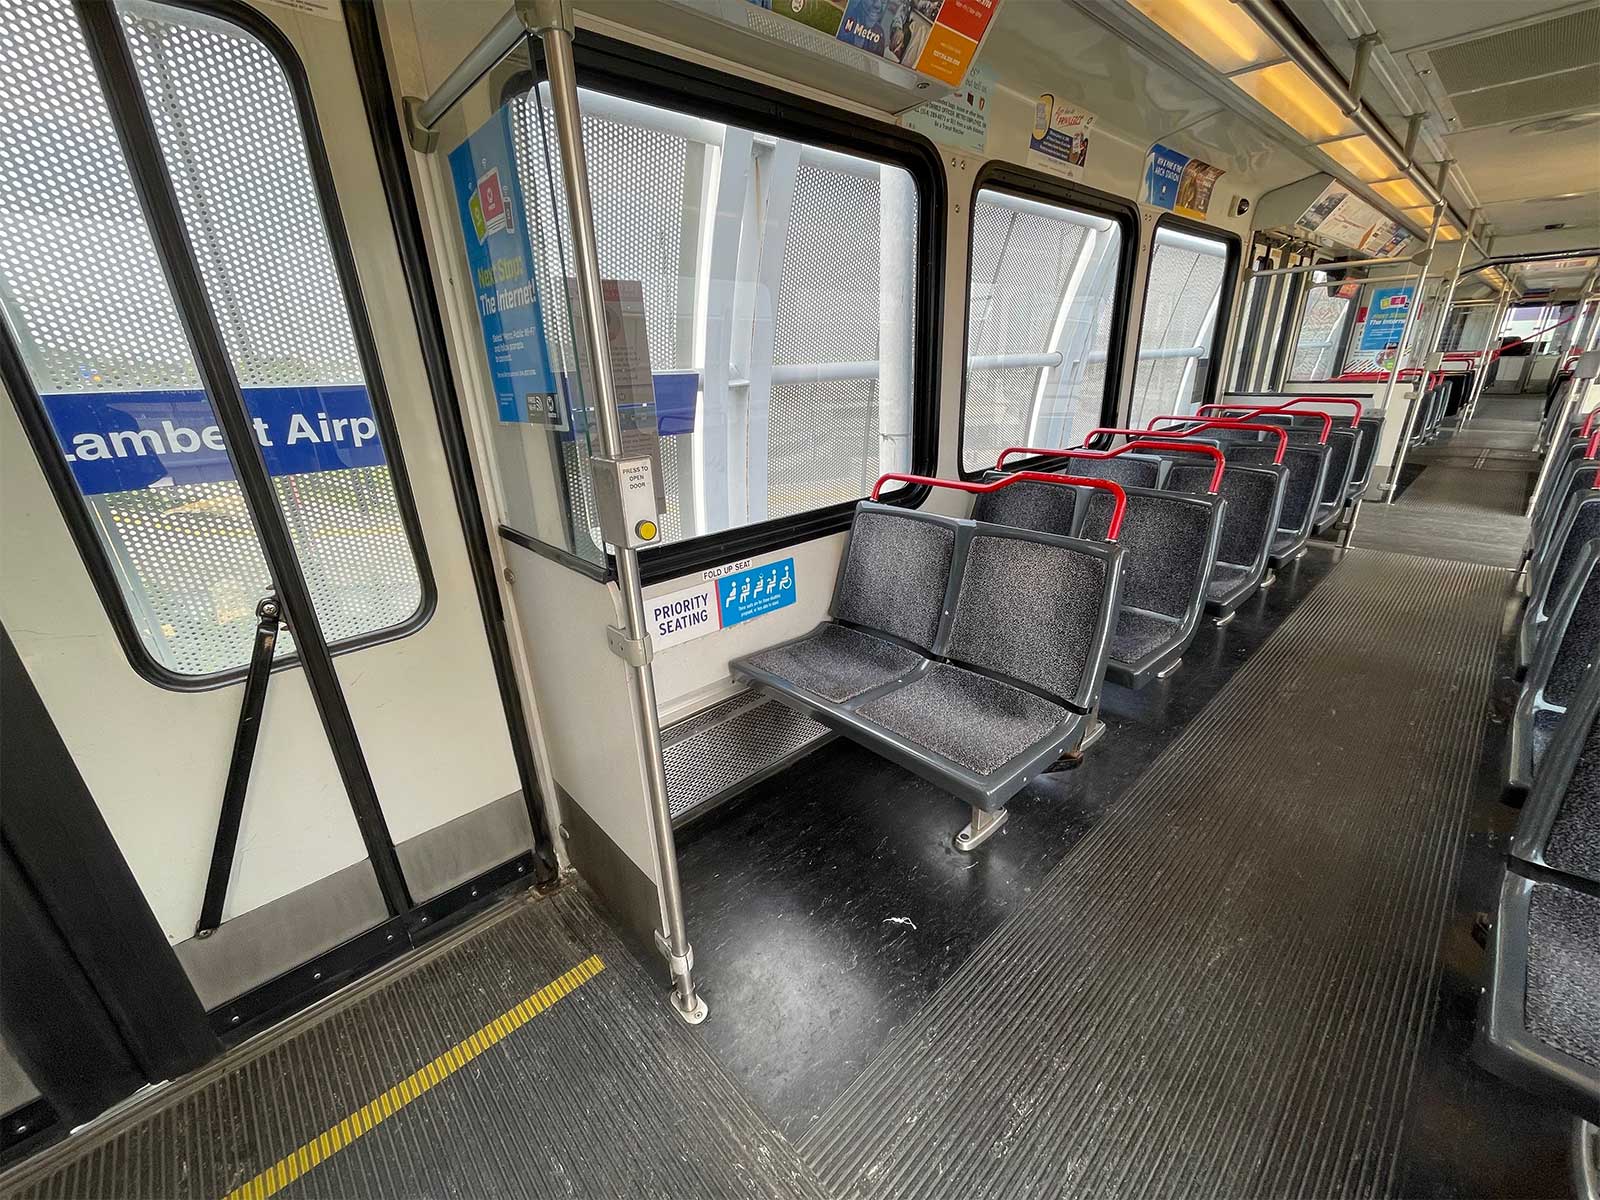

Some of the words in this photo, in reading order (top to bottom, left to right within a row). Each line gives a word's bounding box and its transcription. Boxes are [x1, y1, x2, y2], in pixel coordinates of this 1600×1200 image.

[854, 23, 880, 43] Metro
[477, 265, 497, 288] Next
[480, 293, 496, 316] The
[496, 278, 537, 312] Internet!
[66, 417, 274, 462] ambet
[703, 568, 722, 580] FOLD
[723, 565, 733, 575] UP
[734, 560, 751, 571] SEAT
[654, 593, 708, 621] PRIORITY
[659, 609, 708, 636] SEATING
